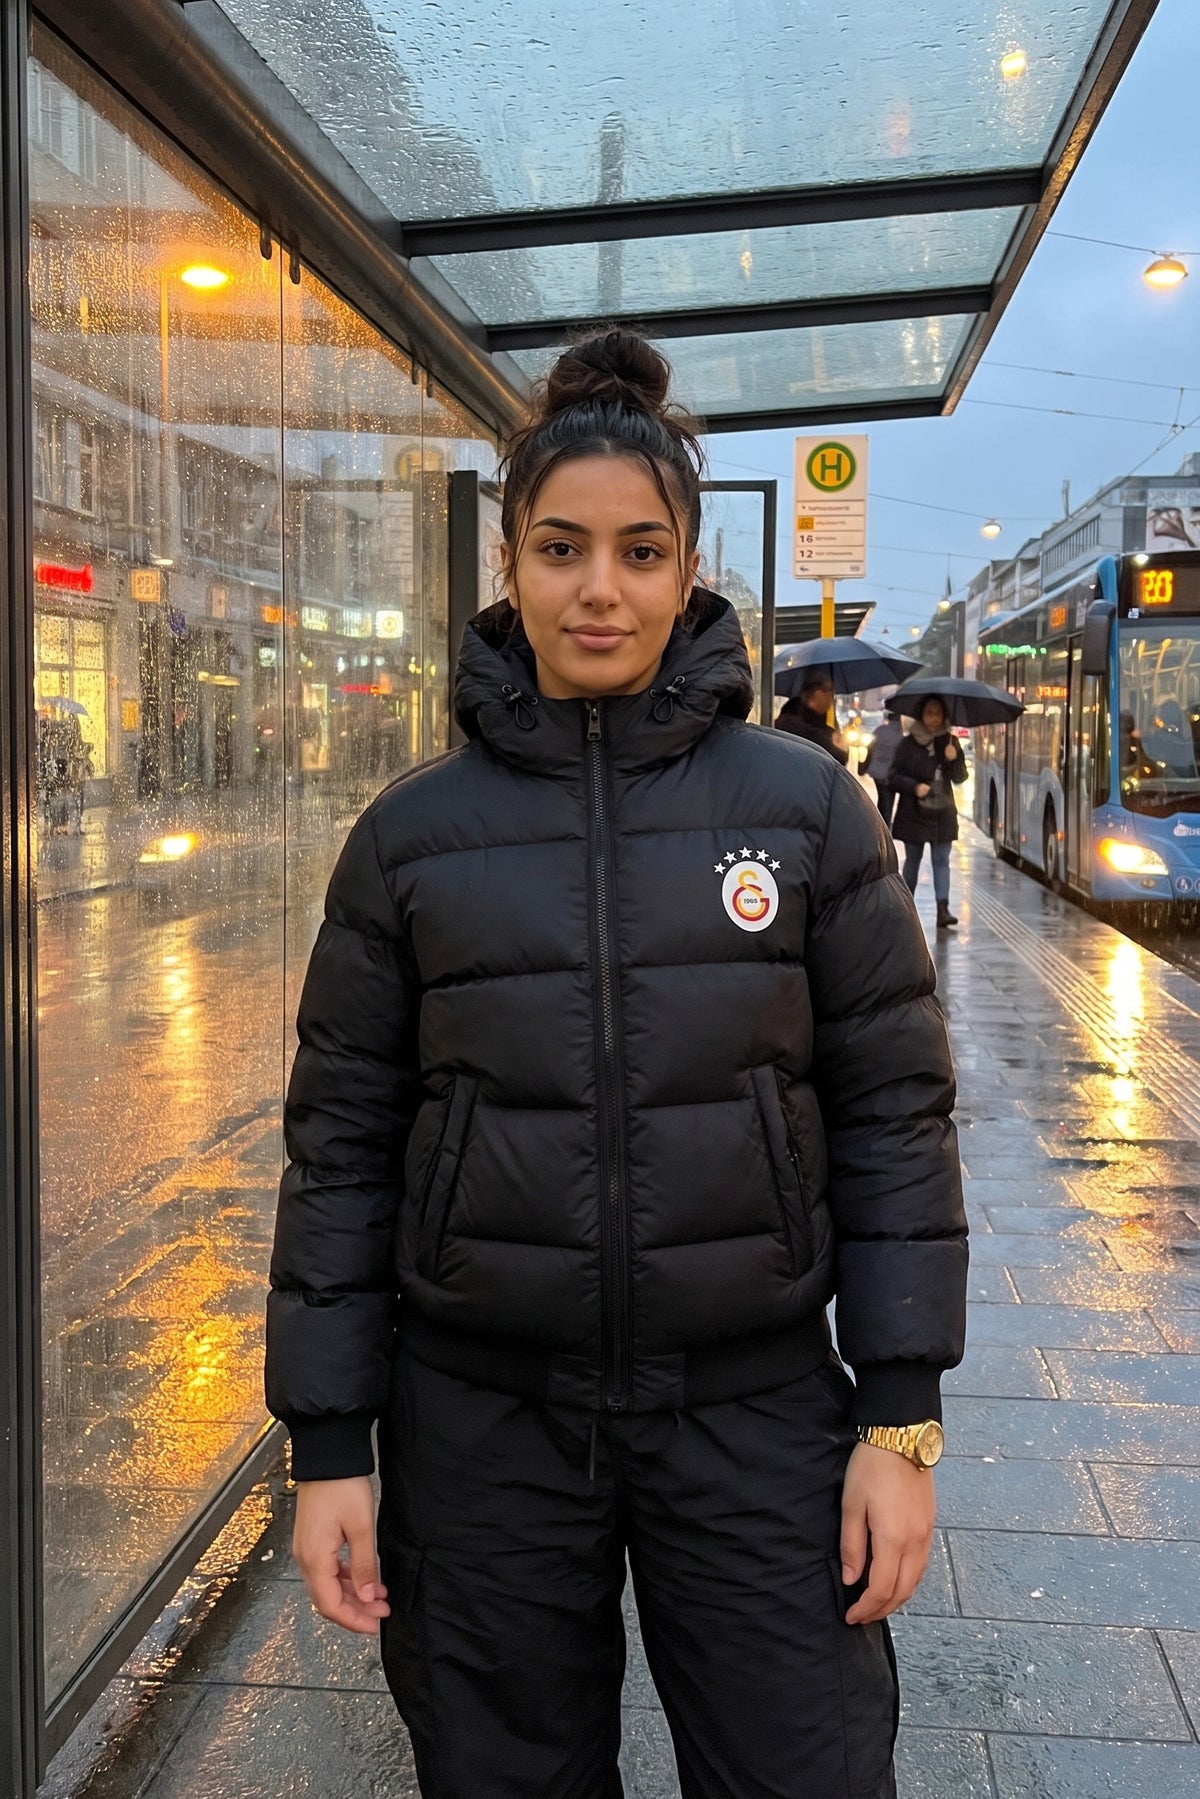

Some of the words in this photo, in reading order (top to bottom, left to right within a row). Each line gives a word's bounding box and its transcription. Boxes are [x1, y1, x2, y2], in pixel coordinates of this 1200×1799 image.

[820, 453, 842, 482] H
[800, 535, 813, 543] 16
[800, 550, 813, 559] 12
